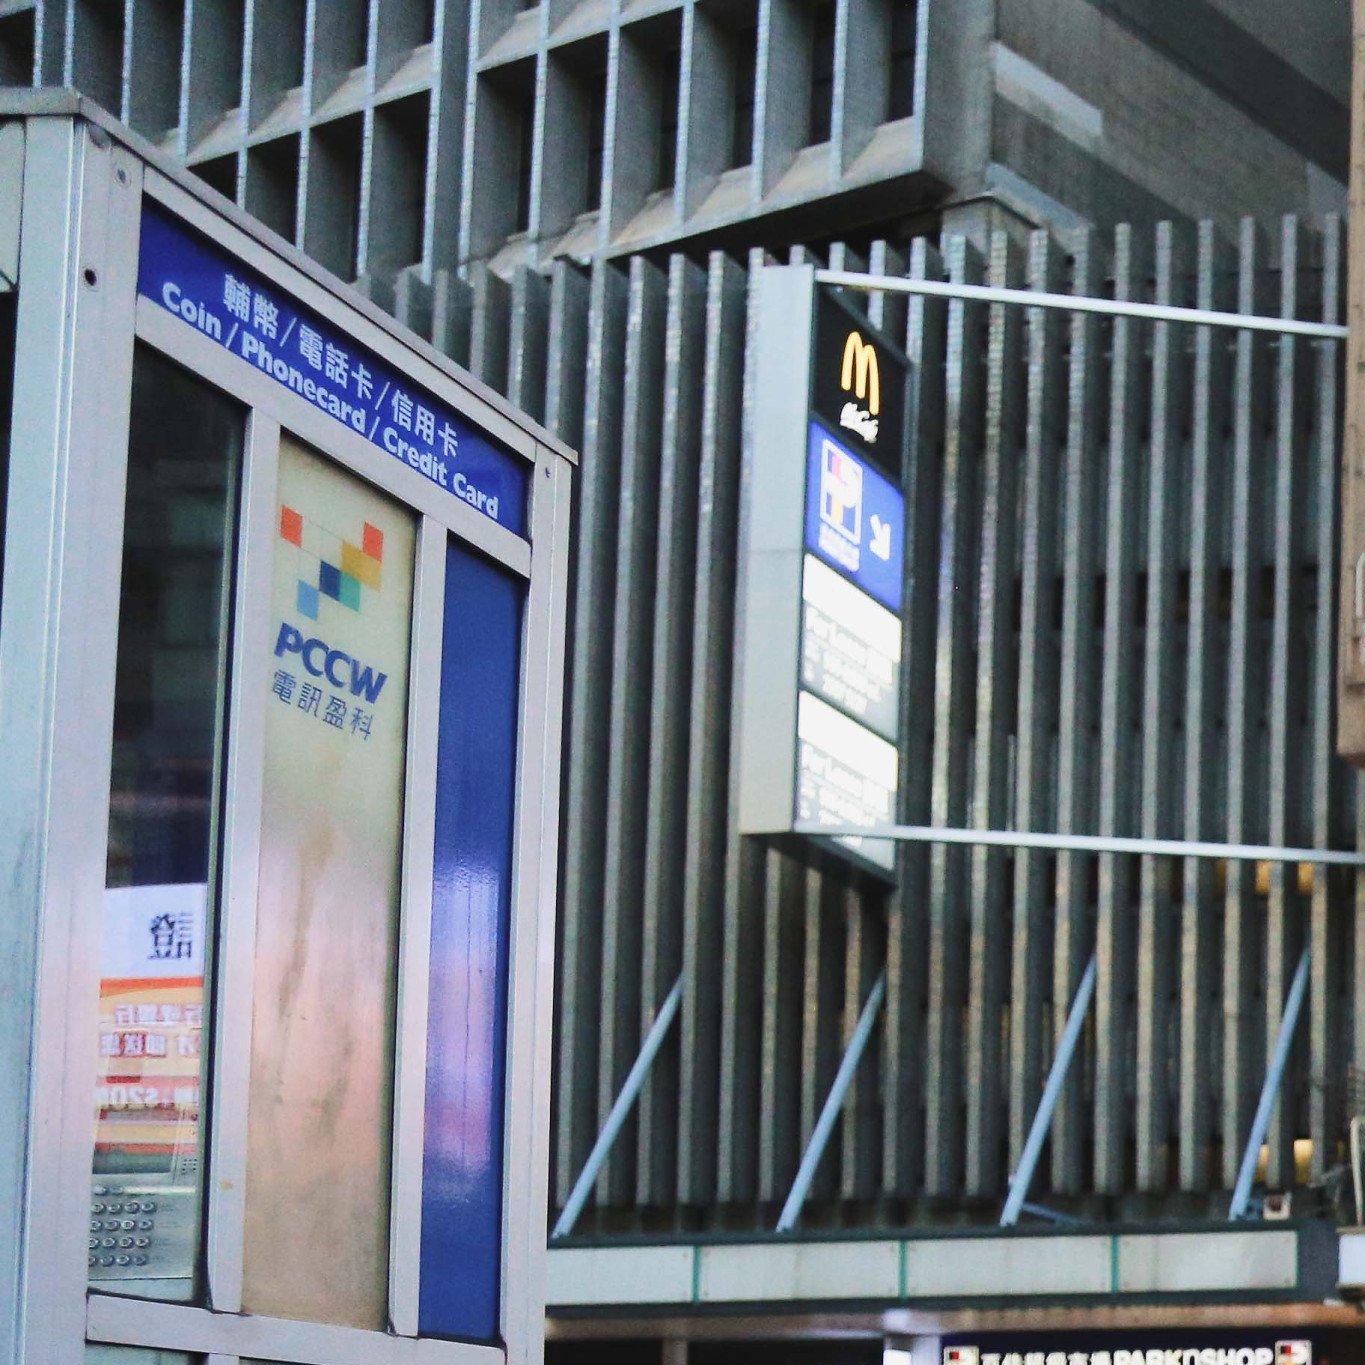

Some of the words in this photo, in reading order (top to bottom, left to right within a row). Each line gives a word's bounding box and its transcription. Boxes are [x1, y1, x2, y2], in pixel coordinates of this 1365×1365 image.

[452, 472, 500, 520] Card
[274, 622, 387, 705] PCCW
[271, 668, 374, 742] 電訊盈科
